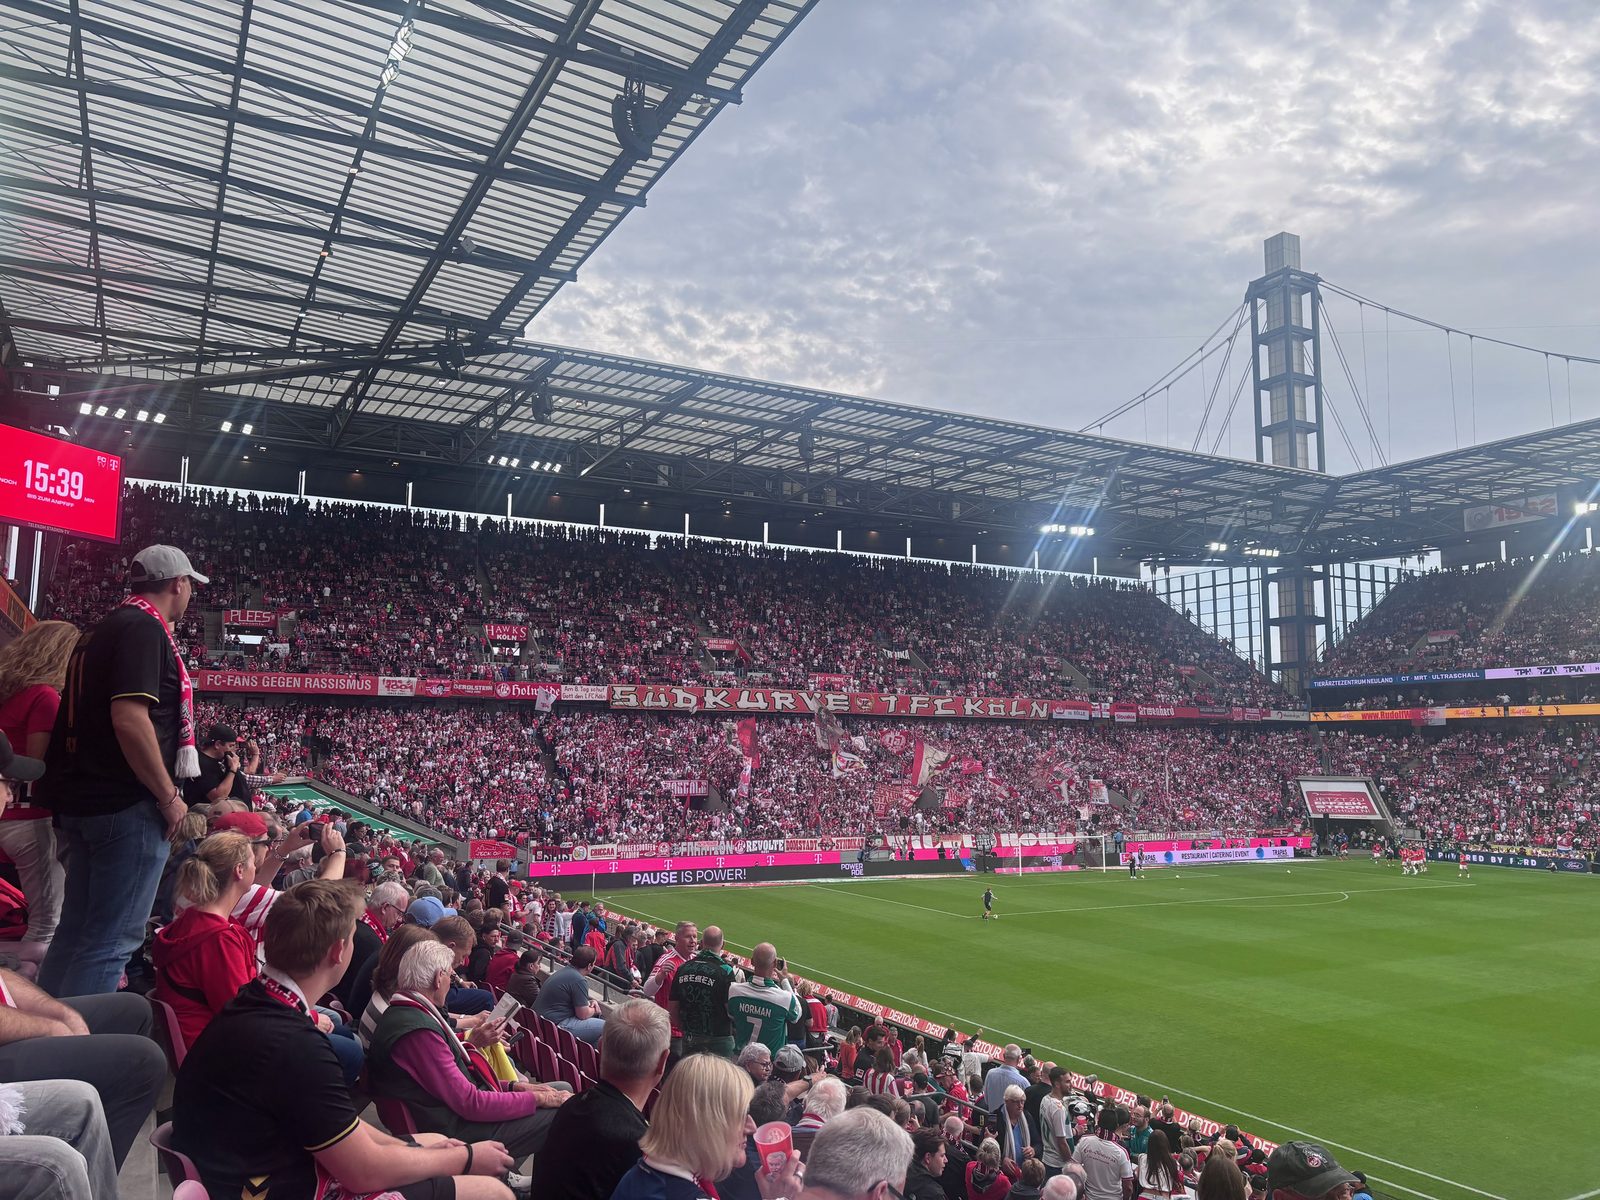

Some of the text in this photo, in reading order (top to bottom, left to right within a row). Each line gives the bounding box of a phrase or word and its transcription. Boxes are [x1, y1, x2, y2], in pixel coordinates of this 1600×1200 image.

[24, 459, 84, 500] 15:39
[37, 495, 51, 503] ZUM
[51, 498, 75, 508] ANPFIFF
[230, 609, 271, 622] PLEES
[485, 625, 527, 638] HAWKS
[497, 633, 517, 641] KÖLN
[207, 674, 258, 687] FC-FANS
[262, 676, 301, 688] GEGEN
[305, 677, 372, 690] RASSISMUS
[1367, 677, 1393, 685] NEULAND
[1431, 671, 1479, 681] ULTRASCHALL
[612, 685, 850, 712] SÜDKURVE
[963, 697, 1048, 719] KÖLN
[746, 839, 784, 853] REVOLTE
[1212, 851, 1232, 859] CATERING
[1235, 850, 1249, 858] EVENT
[1491, 856, 1503, 864] BY
[841, 862, 864, 871] POWER
[633, 868, 746, 885] PAUSE IS POWER!
[678, 974, 716, 987] BREMEN
[739, 1003, 771, 1018] NORMAN
[746, 1015, 763, 1042] 7
[855, 998, 884, 1016] DERTOUR
[889, 1009, 920, 1028] DERTOUR
[968, 1037, 1002, 1059] ERTOUR
